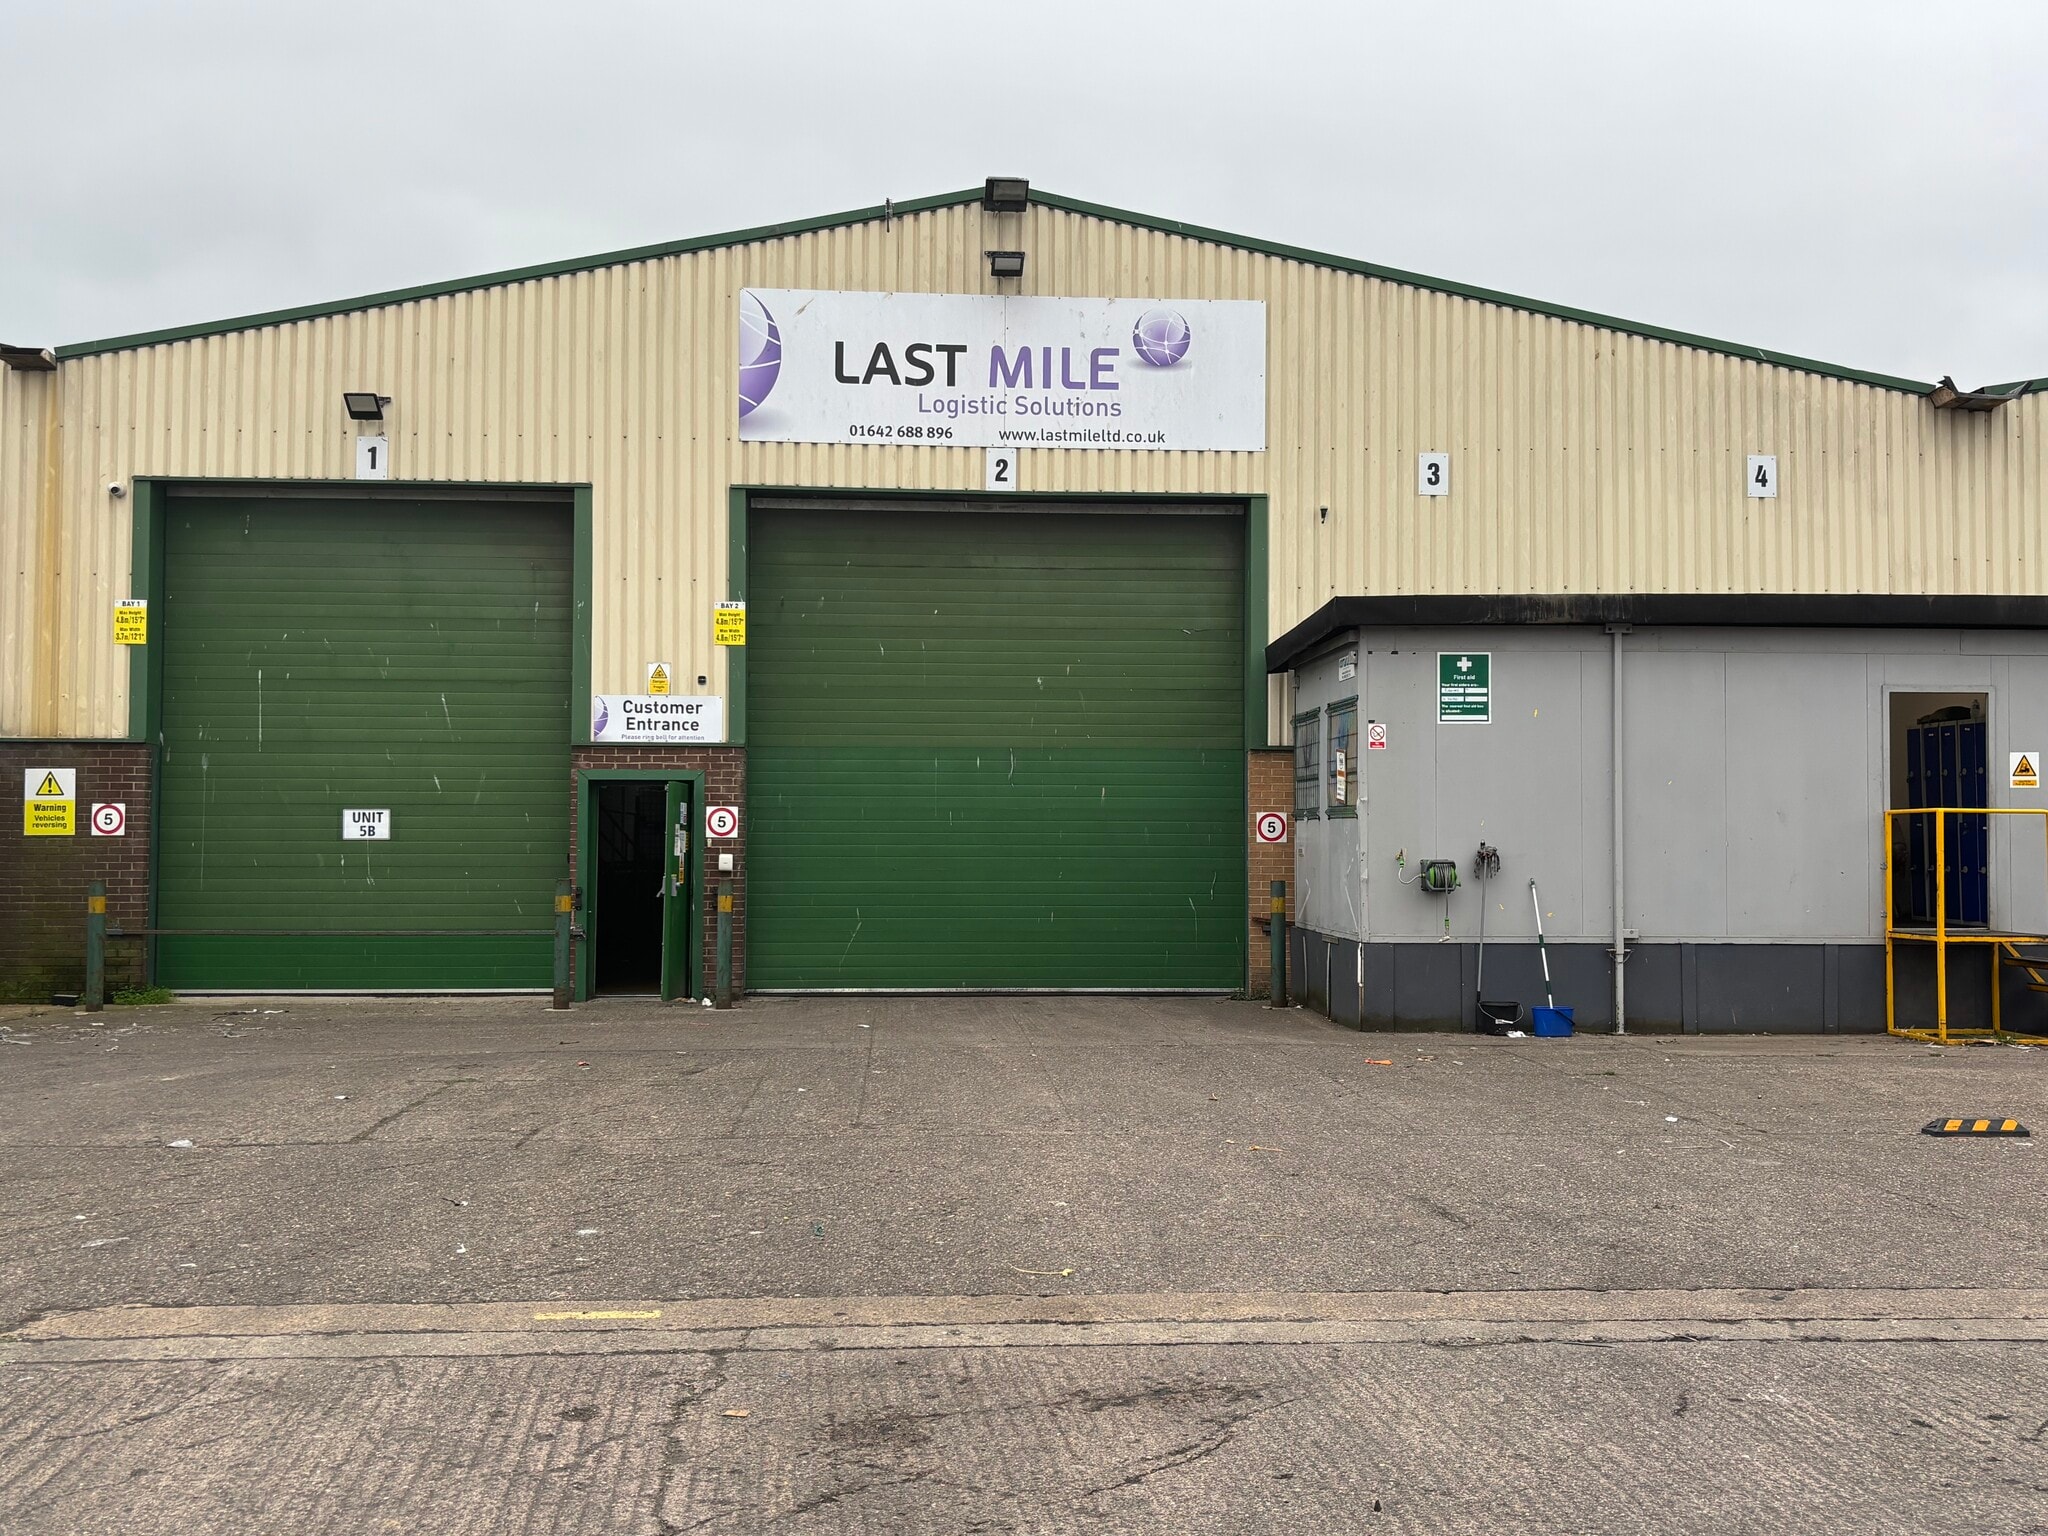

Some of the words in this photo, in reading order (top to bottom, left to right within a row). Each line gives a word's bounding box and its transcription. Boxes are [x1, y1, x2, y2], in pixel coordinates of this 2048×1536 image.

[835, 341, 967, 387] LAST
[989, 345, 1120, 390] MILE
[919, 393, 1007, 419] Logistic
[1015, 396, 1122, 416] Solutions
[849, 424, 893, 437] 01642
[897, 426, 923, 438] 688
[927, 427, 953, 439] 896
[999, 428, 1166, 443] www.lastmileltd.co.uk
[367, 446, 377, 470] 1
[995, 458, 1009, 482] 2
[1427, 462, 1440, 486] 3
[1754, 464, 1768, 488] 4
[623, 700, 703, 714] Customer
[626, 717, 700, 731] Entrance
[34, 803, 67, 812] Warning
[103, 813, 113, 825] 5
[352, 811, 384, 823] UNIT
[717, 816, 727, 828] 5
[359, 825, 376, 837] 5B
[1267, 821, 1276, 833] 5
